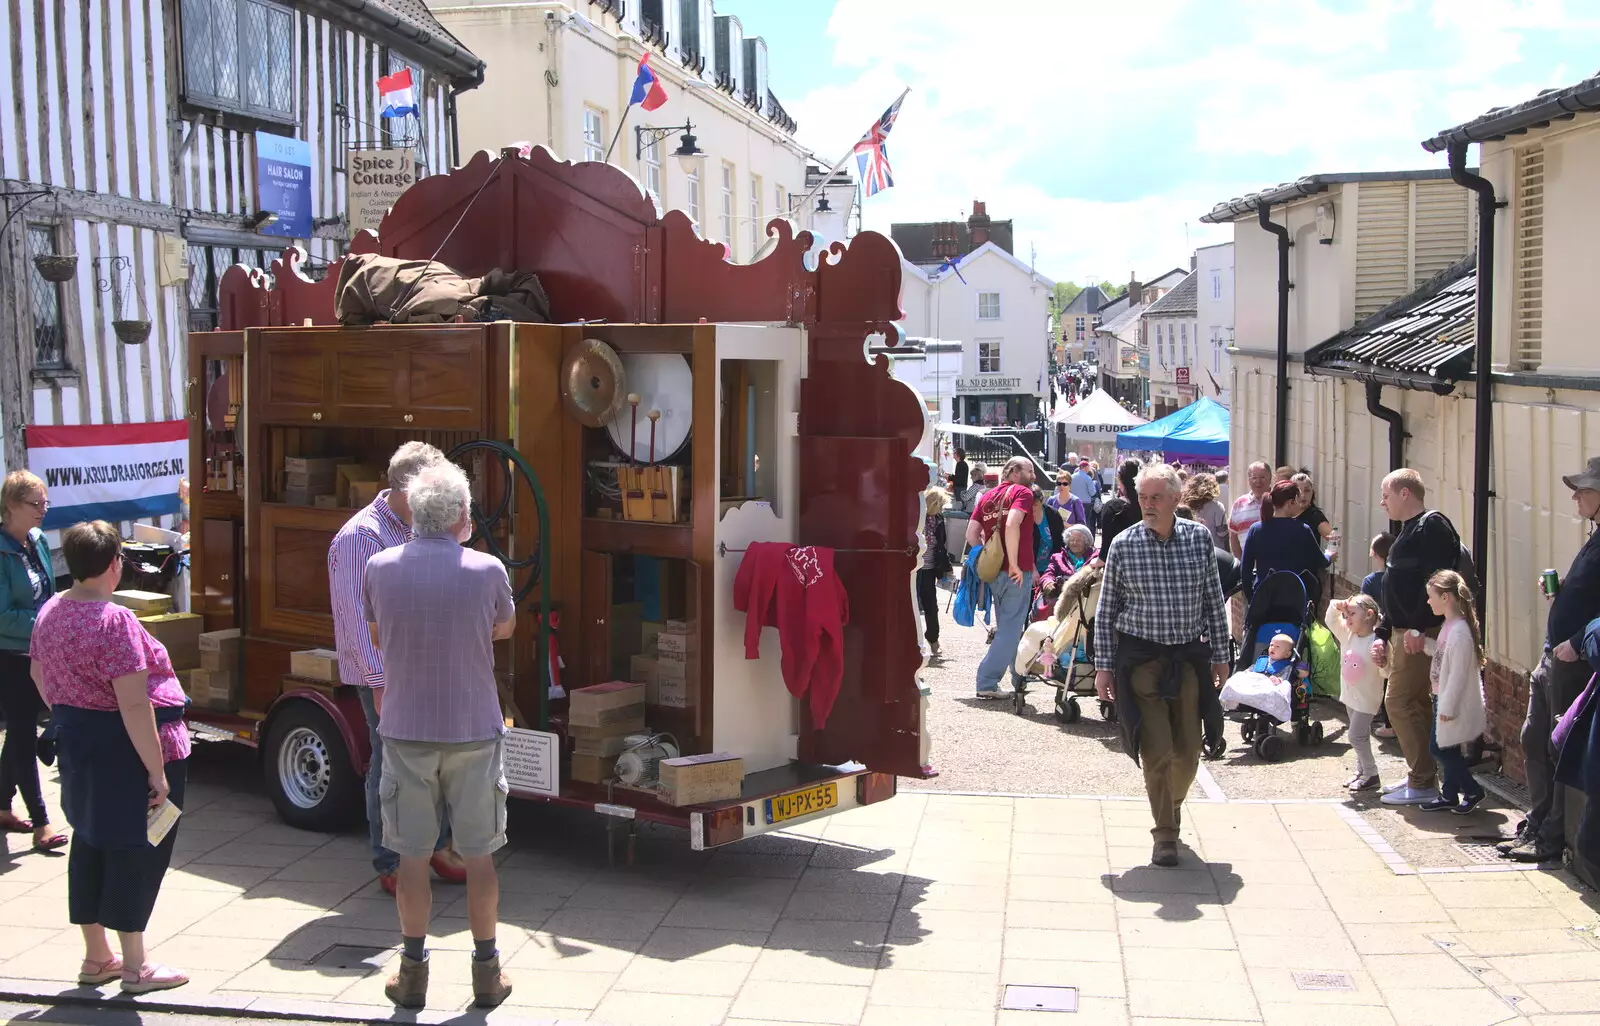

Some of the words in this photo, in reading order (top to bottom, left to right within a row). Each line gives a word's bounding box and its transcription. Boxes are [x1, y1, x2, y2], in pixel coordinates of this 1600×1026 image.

[353, 156, 394, 172] Spice
[267, 164, 283, 178] HAIR
[283, 167, 304, 181] SALON
[353, 171, 412, 188] Cottage
[981, 378, 988, 387] &
[989, 378, 1022, 387] BARRETT
[1076, 425, 1096, 433] FAB
[1099, 425, 1134, 433] FUDGE
[777, 787, 832, 817] WJ-PX-55
